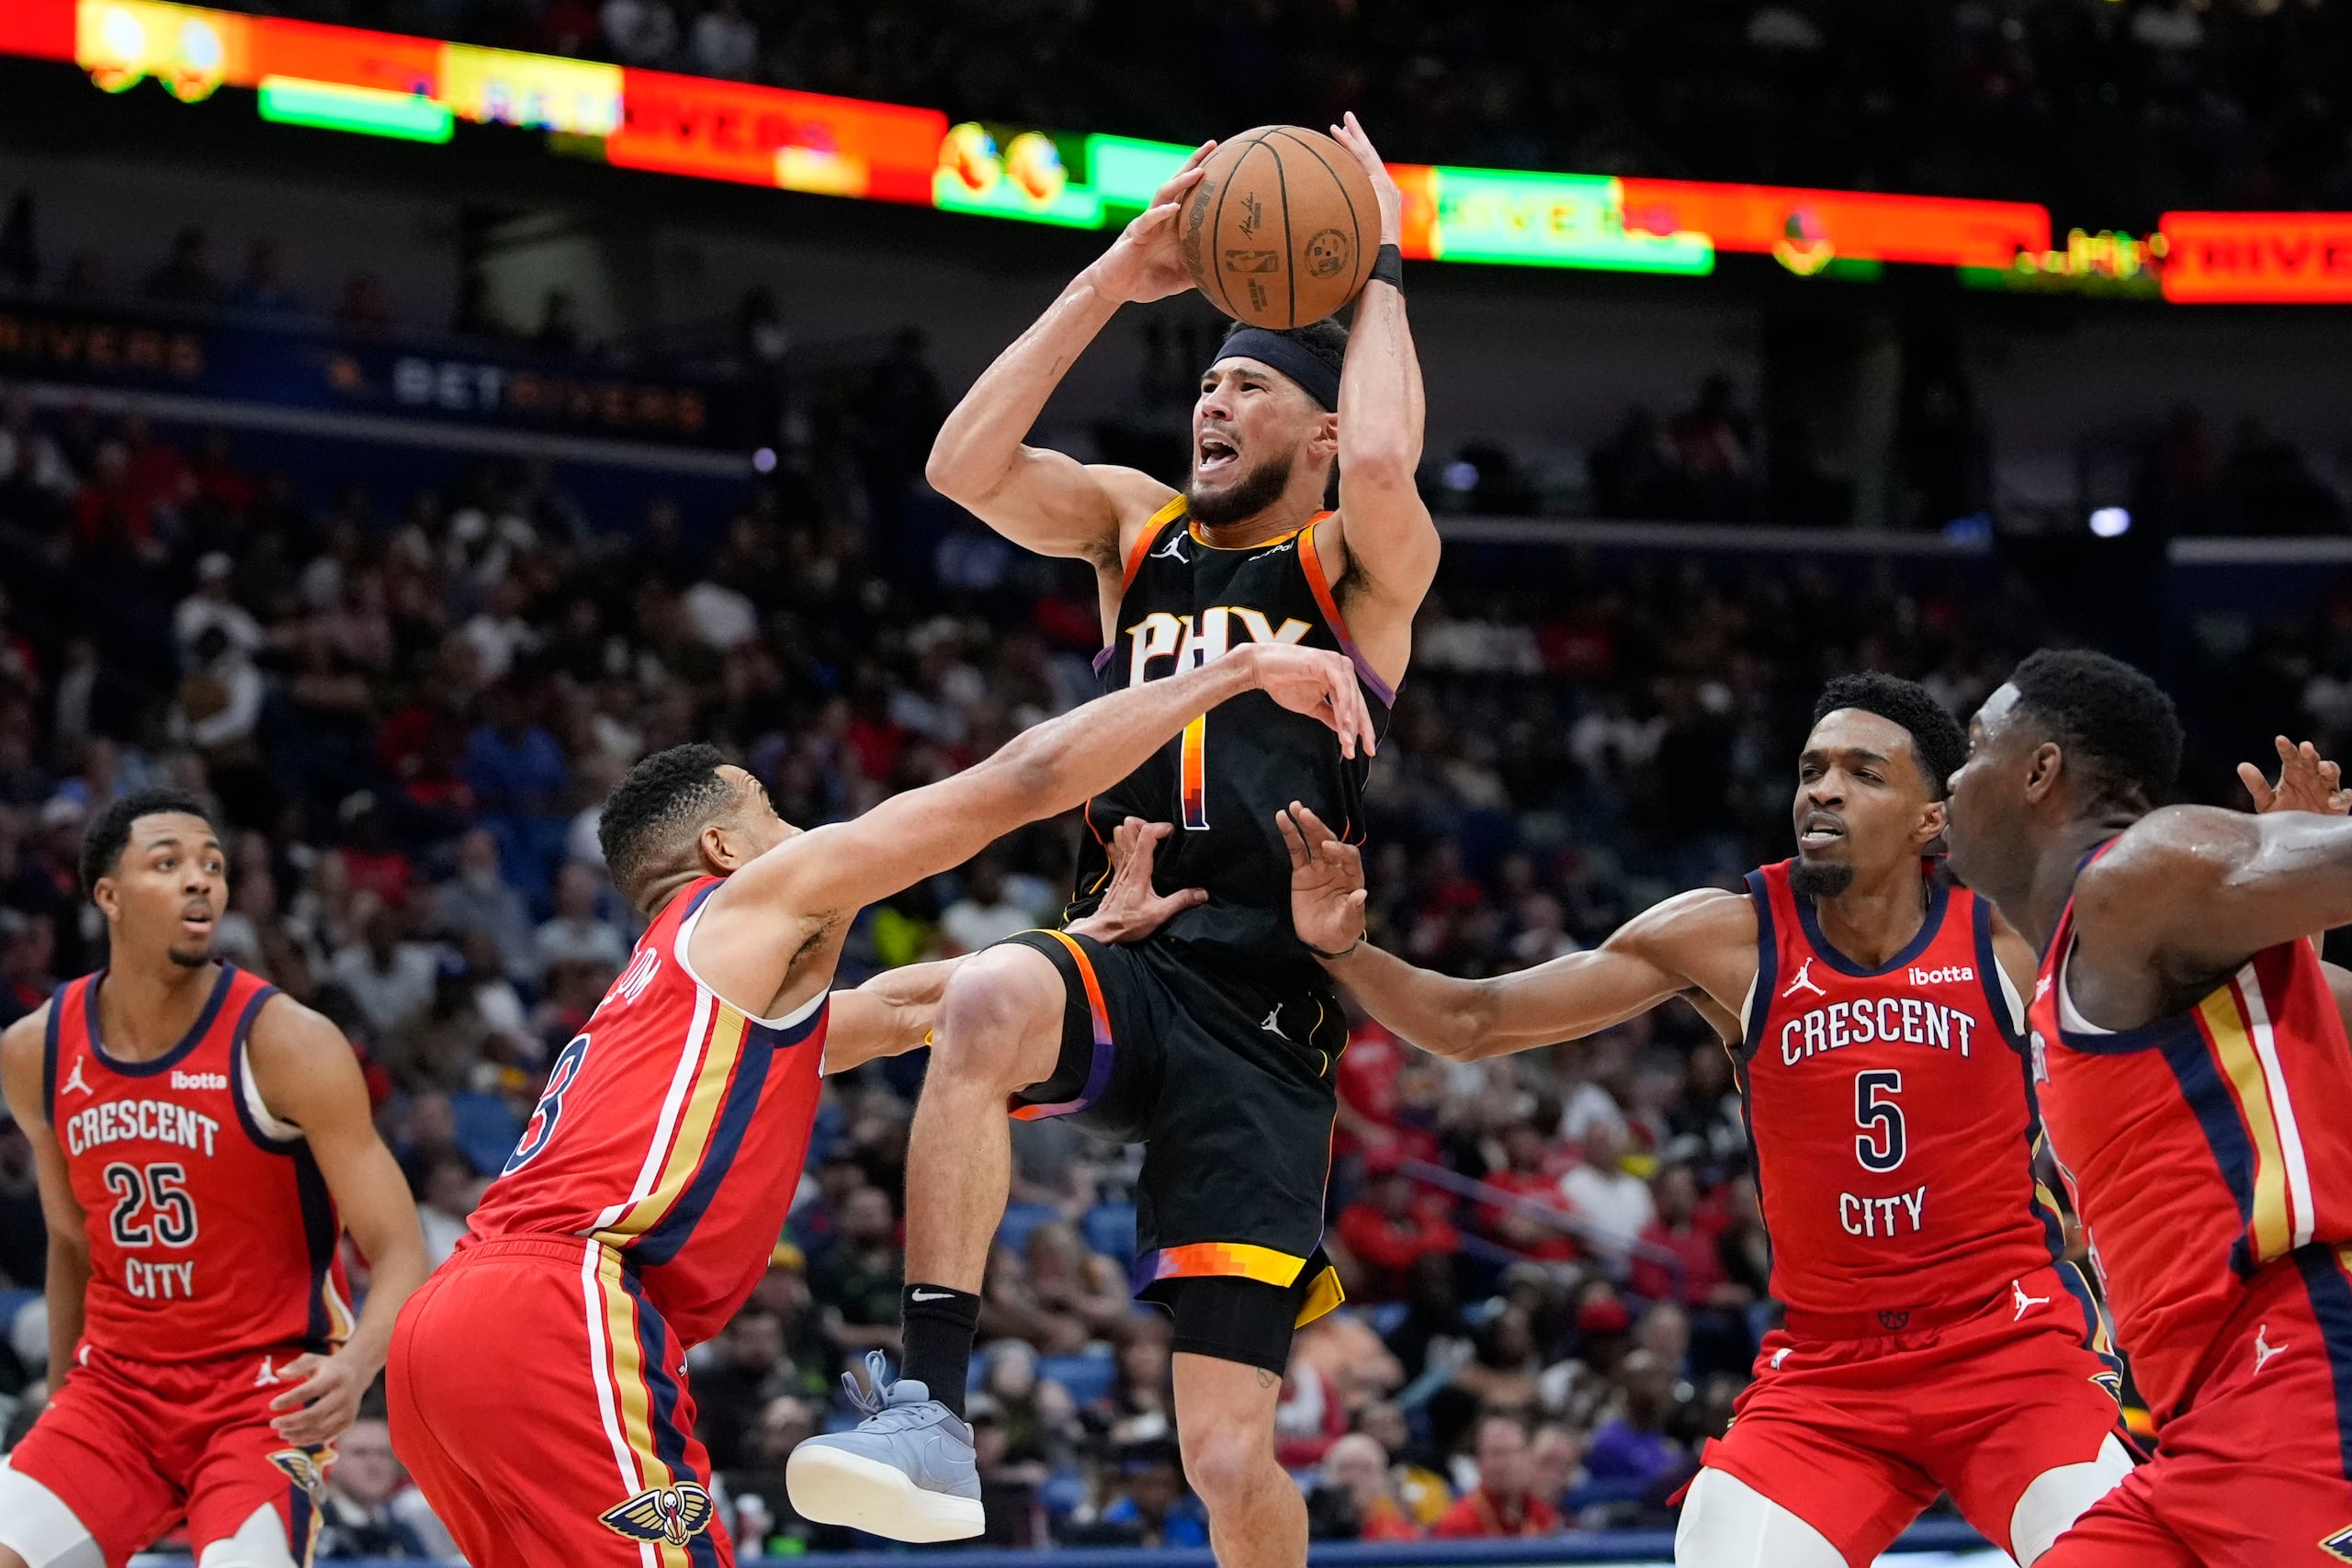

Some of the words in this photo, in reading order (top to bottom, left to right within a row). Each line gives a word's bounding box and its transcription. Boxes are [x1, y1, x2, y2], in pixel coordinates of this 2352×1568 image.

[1181, 713, 1210, 830] 1
[1908, 966, 1974, 987] ibotta
[1781, 997, 1976, 1066] CRESCENT
[171, 1070, 228, 1089] ibotta
[67, 1099, 220, 1157] CRESCENT
[1854, 1068, 1907, 1173] 5
[103, 1161, 198, 1248] 25
[1838, 1184, 1927, 1237] CITY
[125, 1256, 195, 1300] CITY
